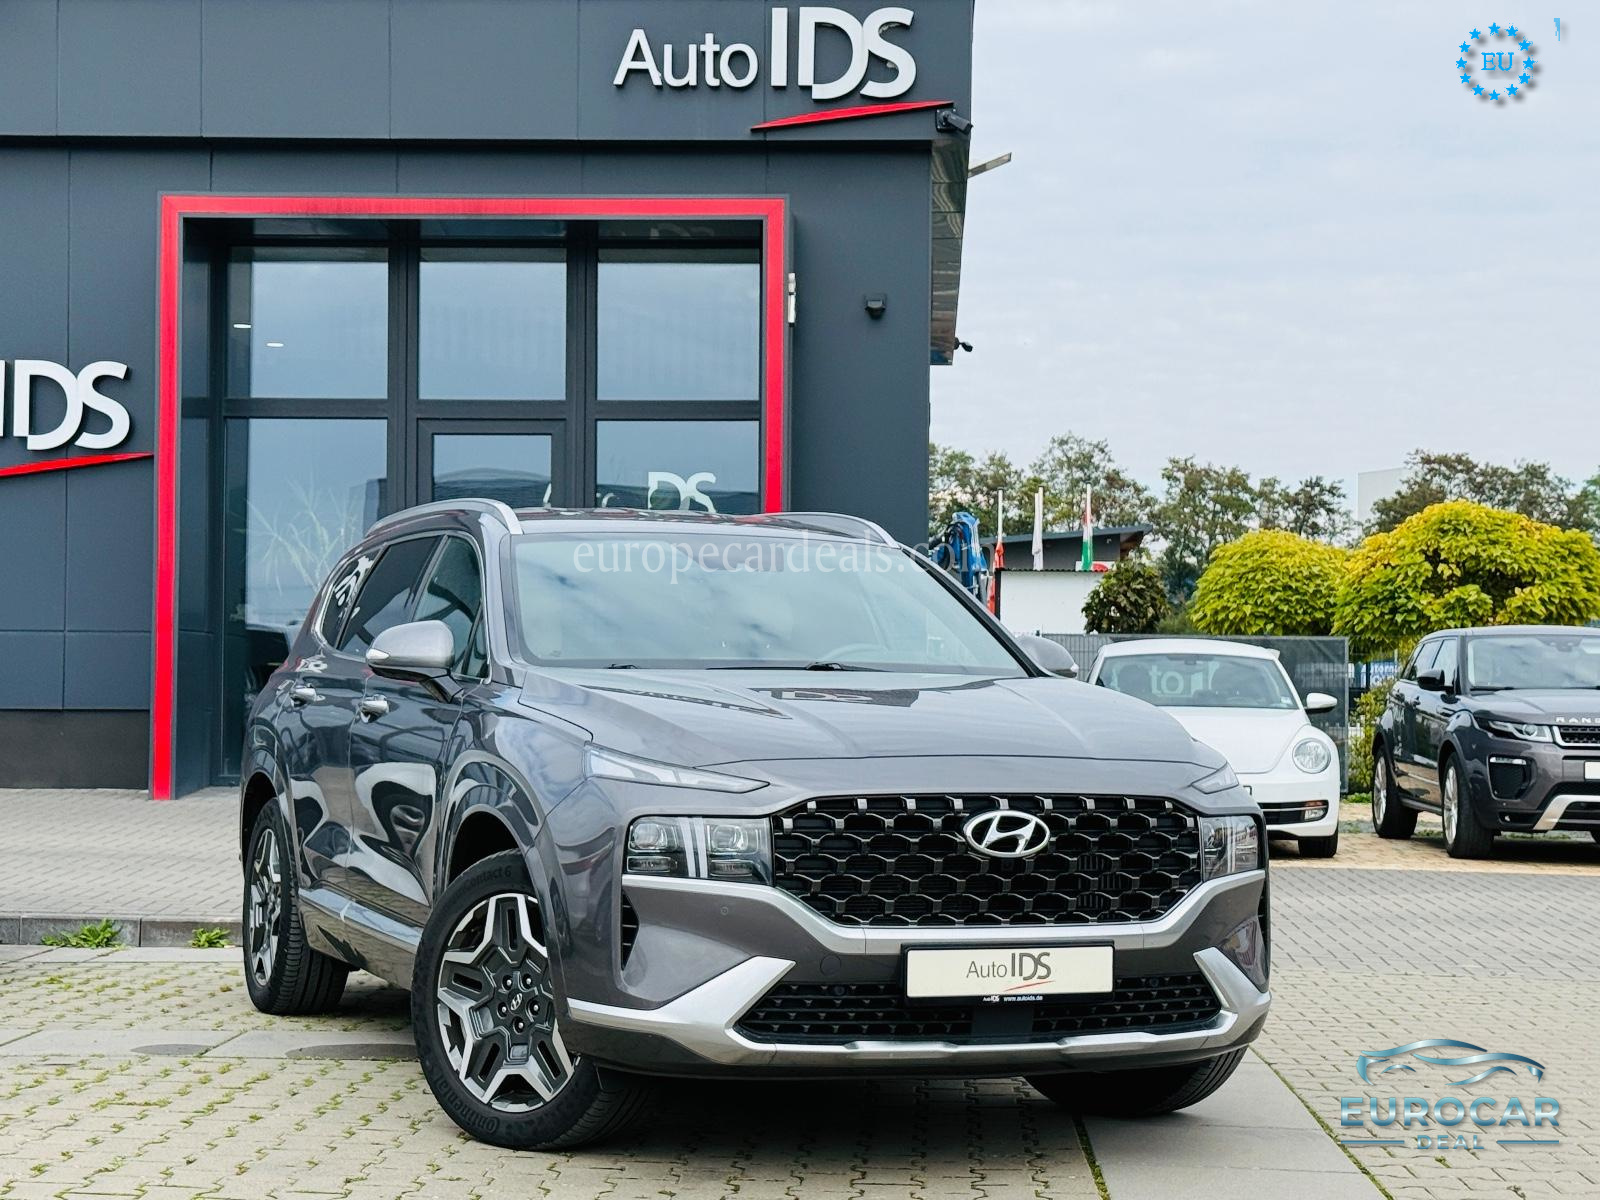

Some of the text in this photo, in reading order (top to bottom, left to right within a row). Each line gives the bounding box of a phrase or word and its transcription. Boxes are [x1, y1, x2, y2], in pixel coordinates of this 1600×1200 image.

[613, 6, 917, 100] Auto IDS
[966, 951, 1052, 981] Auto IDS
